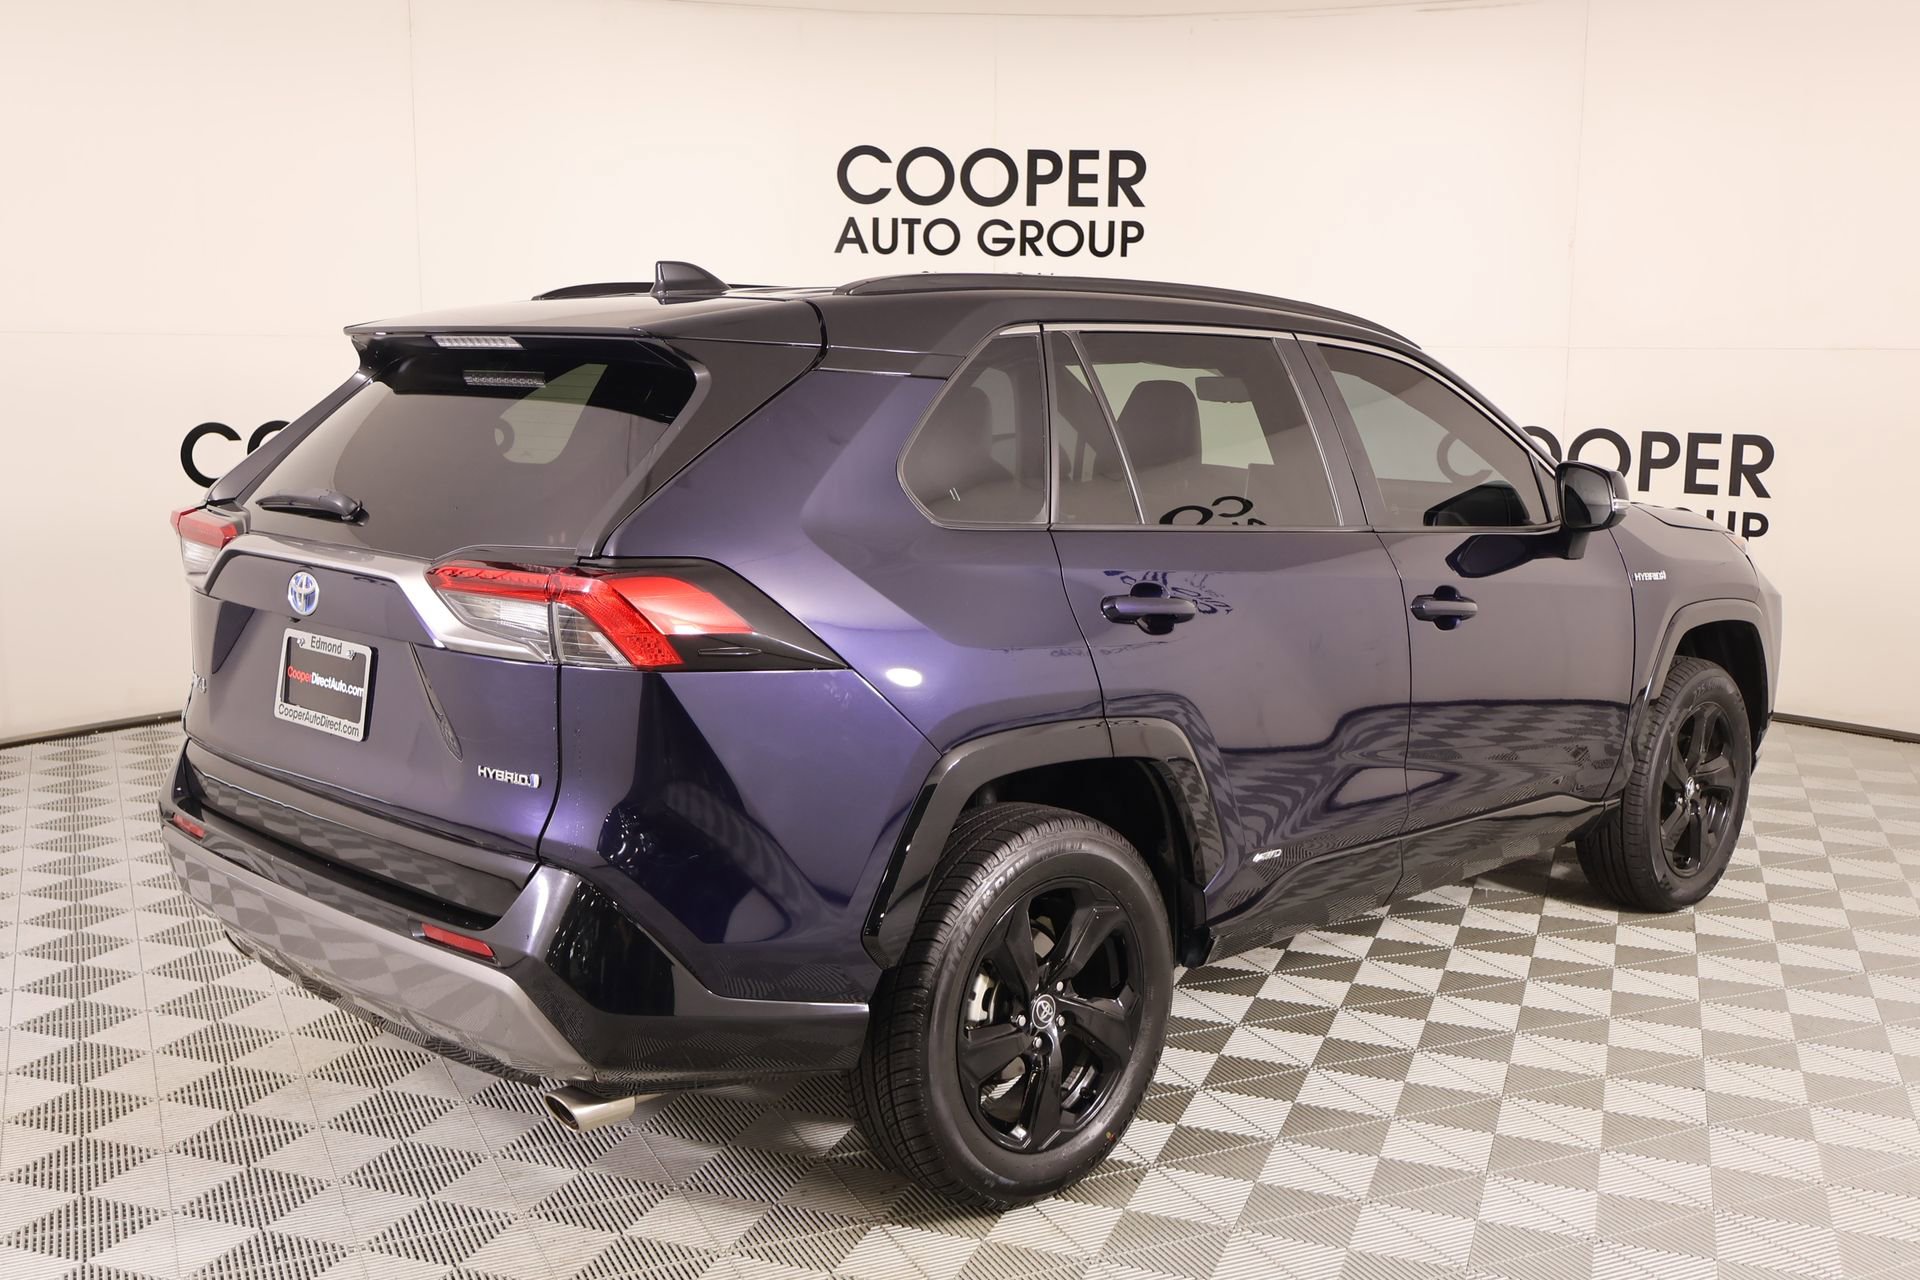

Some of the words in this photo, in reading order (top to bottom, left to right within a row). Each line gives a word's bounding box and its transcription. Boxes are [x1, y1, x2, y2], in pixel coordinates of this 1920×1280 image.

[837, 144, 1147, 207] COOPER
[834, 216, 961, 256] AUTO
[977, 218, 1145, 258] GROUP
[310, 636, 342, 655] Edmond
[287, 665, 364, 698] CooperDirectAuto.com
[278, 703, 360, 738] CooperAutoDirect.com
[477, 765, 528, 786] HYBRID
